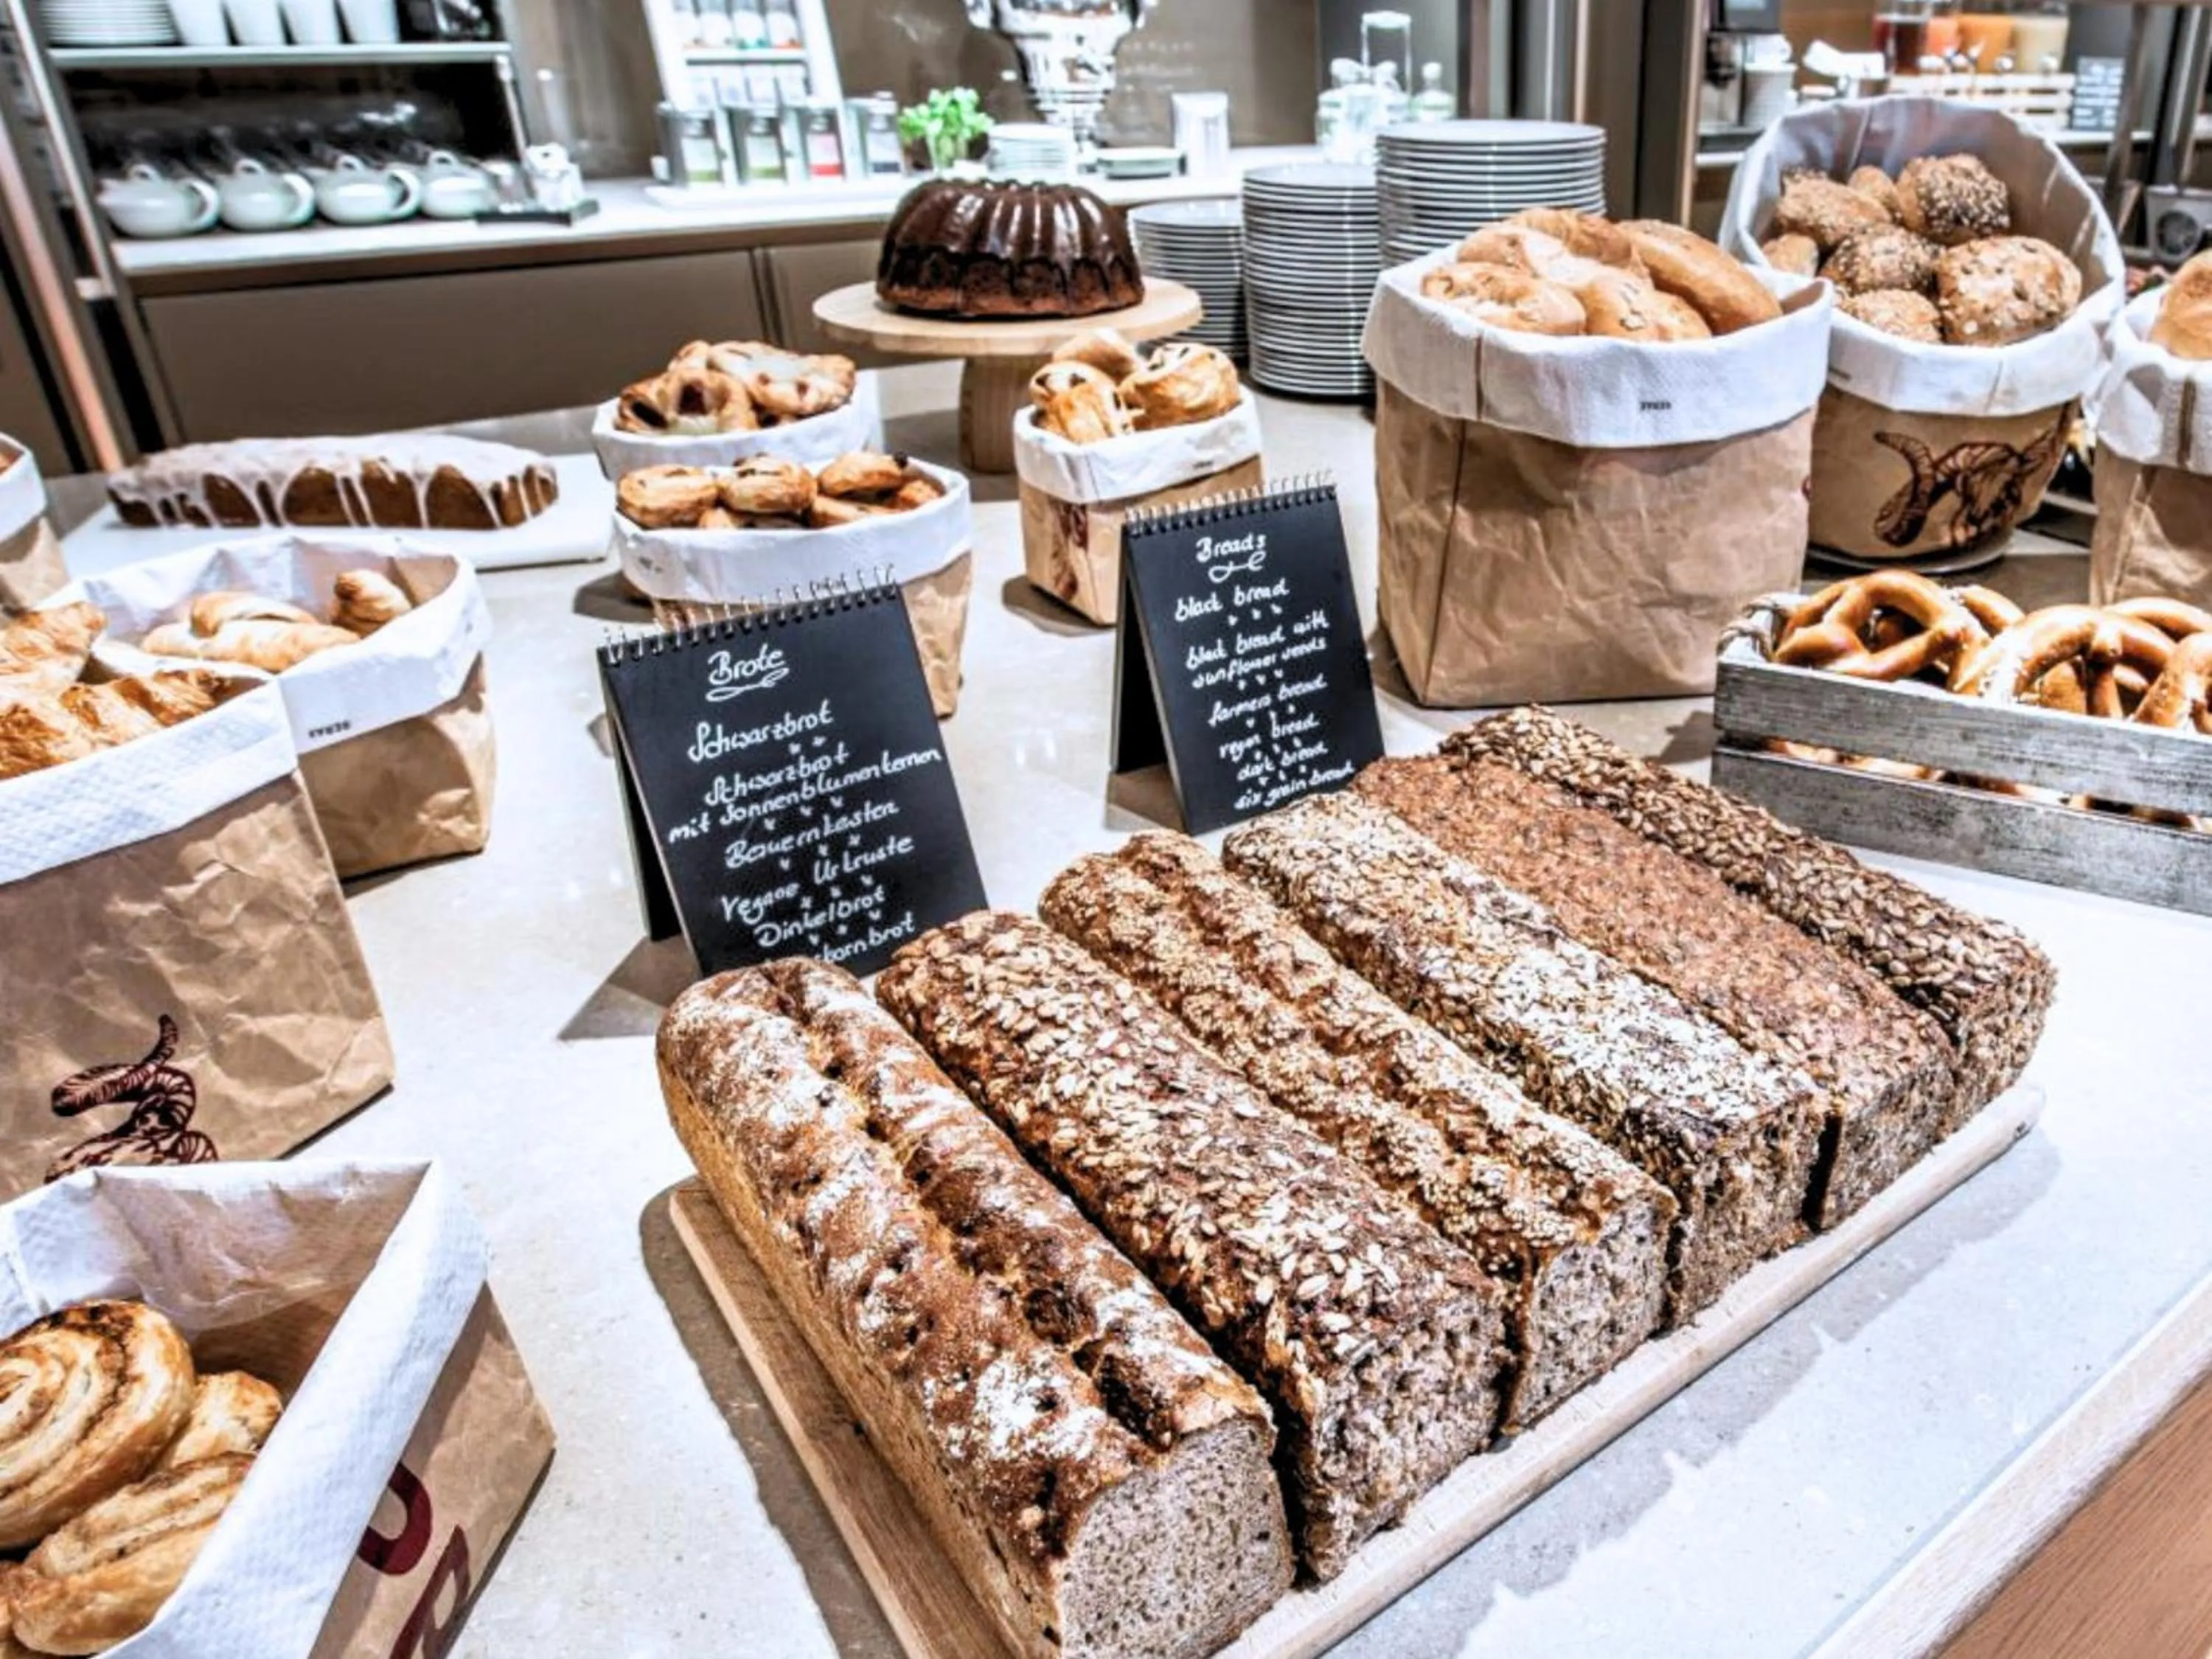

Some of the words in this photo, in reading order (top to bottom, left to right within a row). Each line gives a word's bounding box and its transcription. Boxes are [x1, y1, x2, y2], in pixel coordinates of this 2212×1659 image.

[1195, 532, 1267, 563] Breads
[1174, 591, 1224, 622] black
[1233, 577, 1290, 607] bread
[1235, 625, 1287, 655] bread
[1293, 609, 1330, 634] with
[707, 642, 787, 686] Brote
[1192, 652, 1277, 689] sunflower
[1278, 672, 1328, 701] bread
[686, 698, 834, 763] Schwarzbrot
[1268, 710, 1321, 739] bread
[703, 740, 849, 807] Schwarzbrot
[1281, 740, 1329, 767] bread
[667, 812, 712, 844] mit
[754, 884, 886, 947] Dinkelbrot
